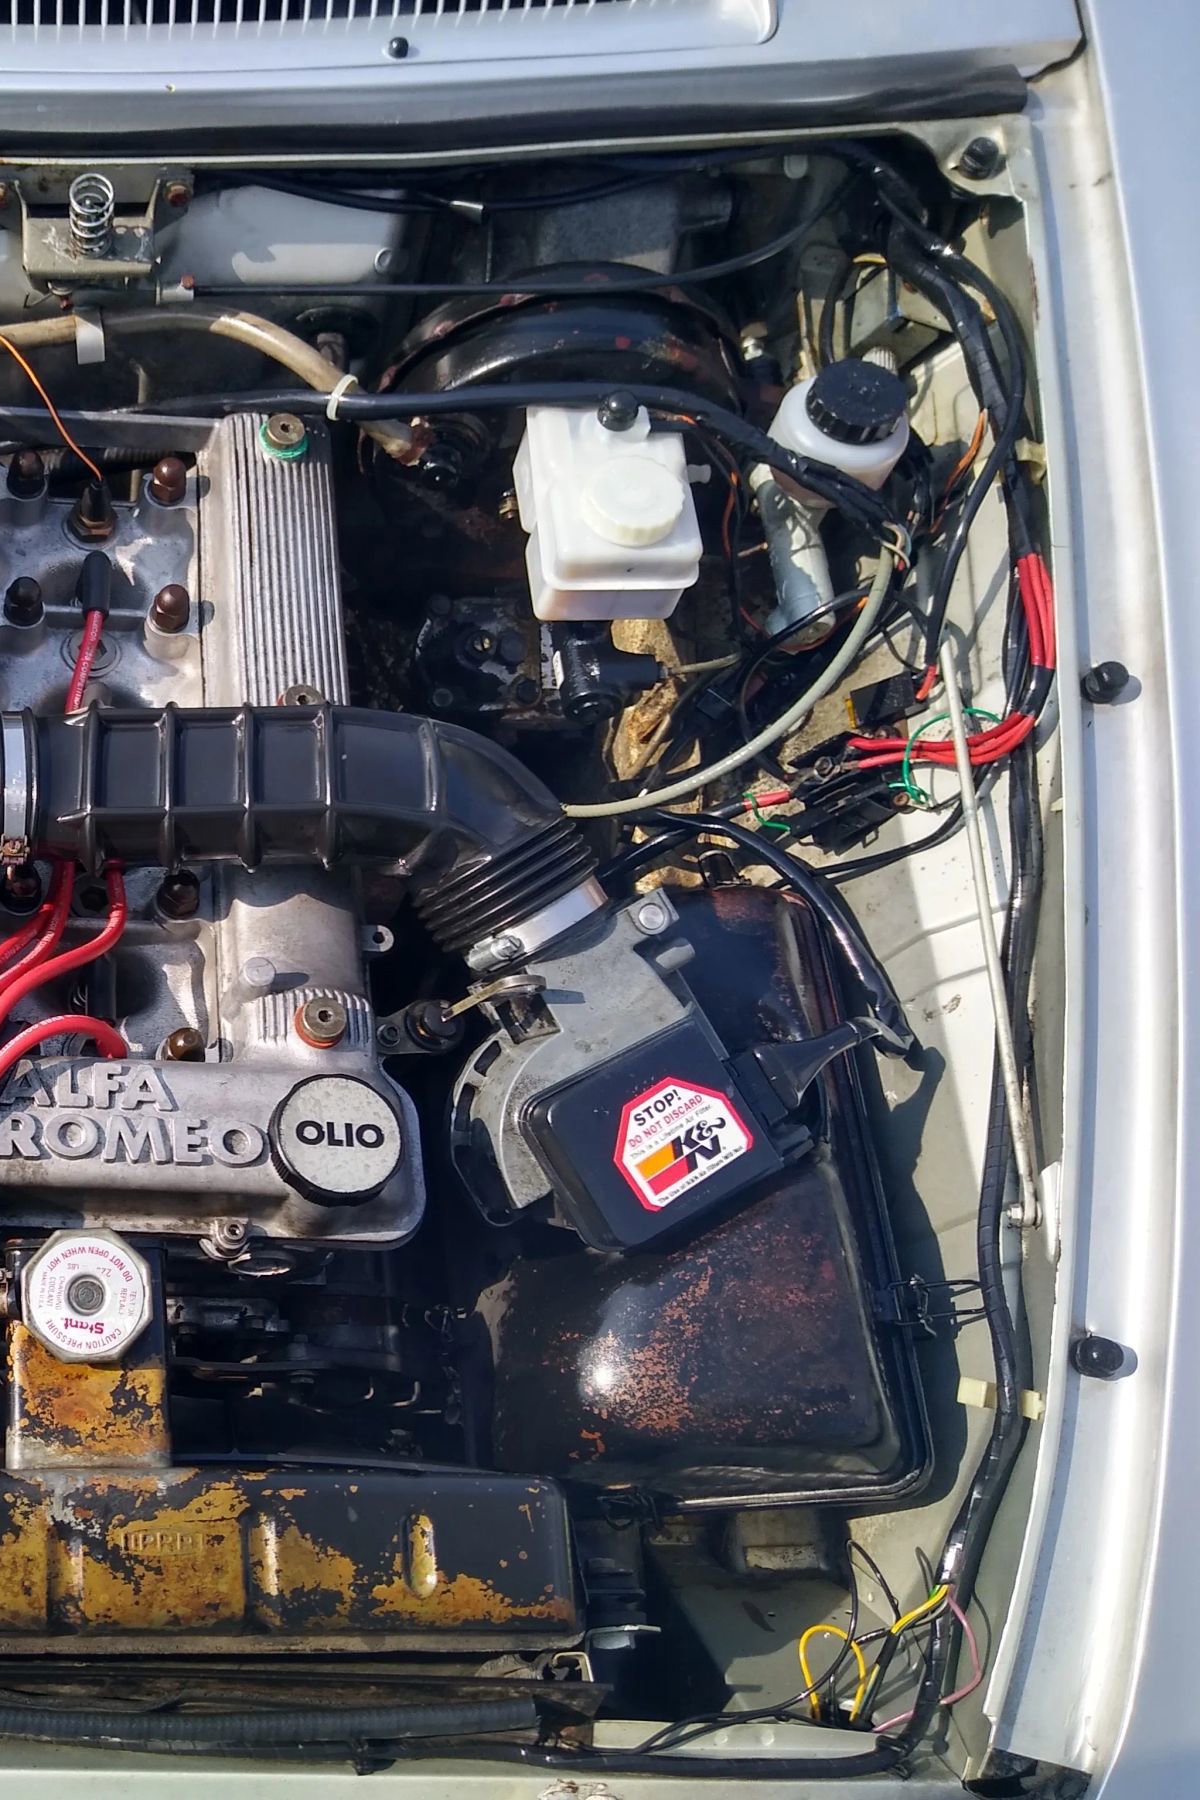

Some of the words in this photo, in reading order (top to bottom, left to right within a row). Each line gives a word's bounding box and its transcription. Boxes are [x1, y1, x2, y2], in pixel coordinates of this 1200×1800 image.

[0, 1060, 174, 1112] ALFA
[634, 1089, 682, 1126] STOP!
[628, 1135, 642, 1148] DO
[643, 1121, 662, 1138] NOT
[664, 1094, 703, 1124] DISCARD
[295, 1120, 386, 1149] OLIO
[62, 1246, 86, 1260] WHEN
[88, 1246, 110, 1259] OPEN
[47, 1257, 61, 1272] HOT
[110, 1255, 126, 1271] NOT
[122, 1270, 134, 1282] DO
[45, 1319, 83, 1350] PRESSURE
[63, 1317, 105, 1335] Stant
[86, 1328, 122, 1351] CAUTION
